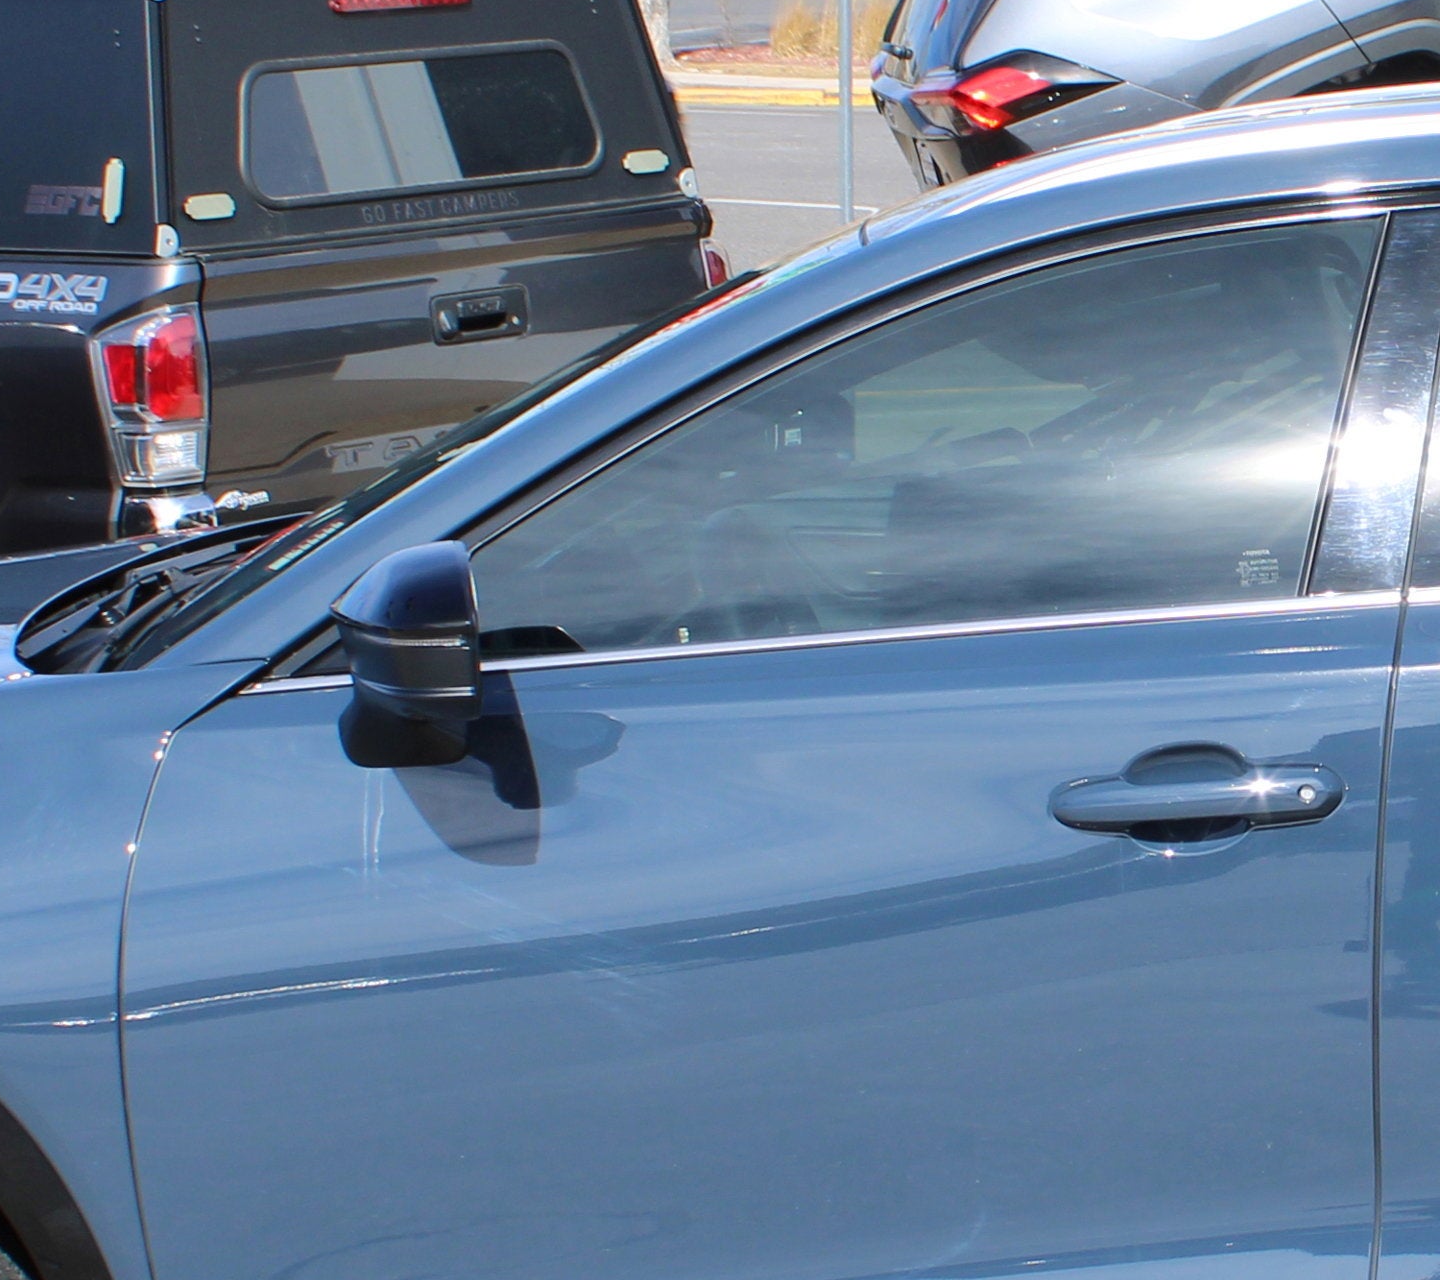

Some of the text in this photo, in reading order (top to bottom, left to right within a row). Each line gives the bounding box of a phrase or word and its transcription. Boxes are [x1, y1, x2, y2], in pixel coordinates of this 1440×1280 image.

[361, 190, 521, 224] GO FAST CAMPERS
[12, 298, 98, 315] OFF ROAD
